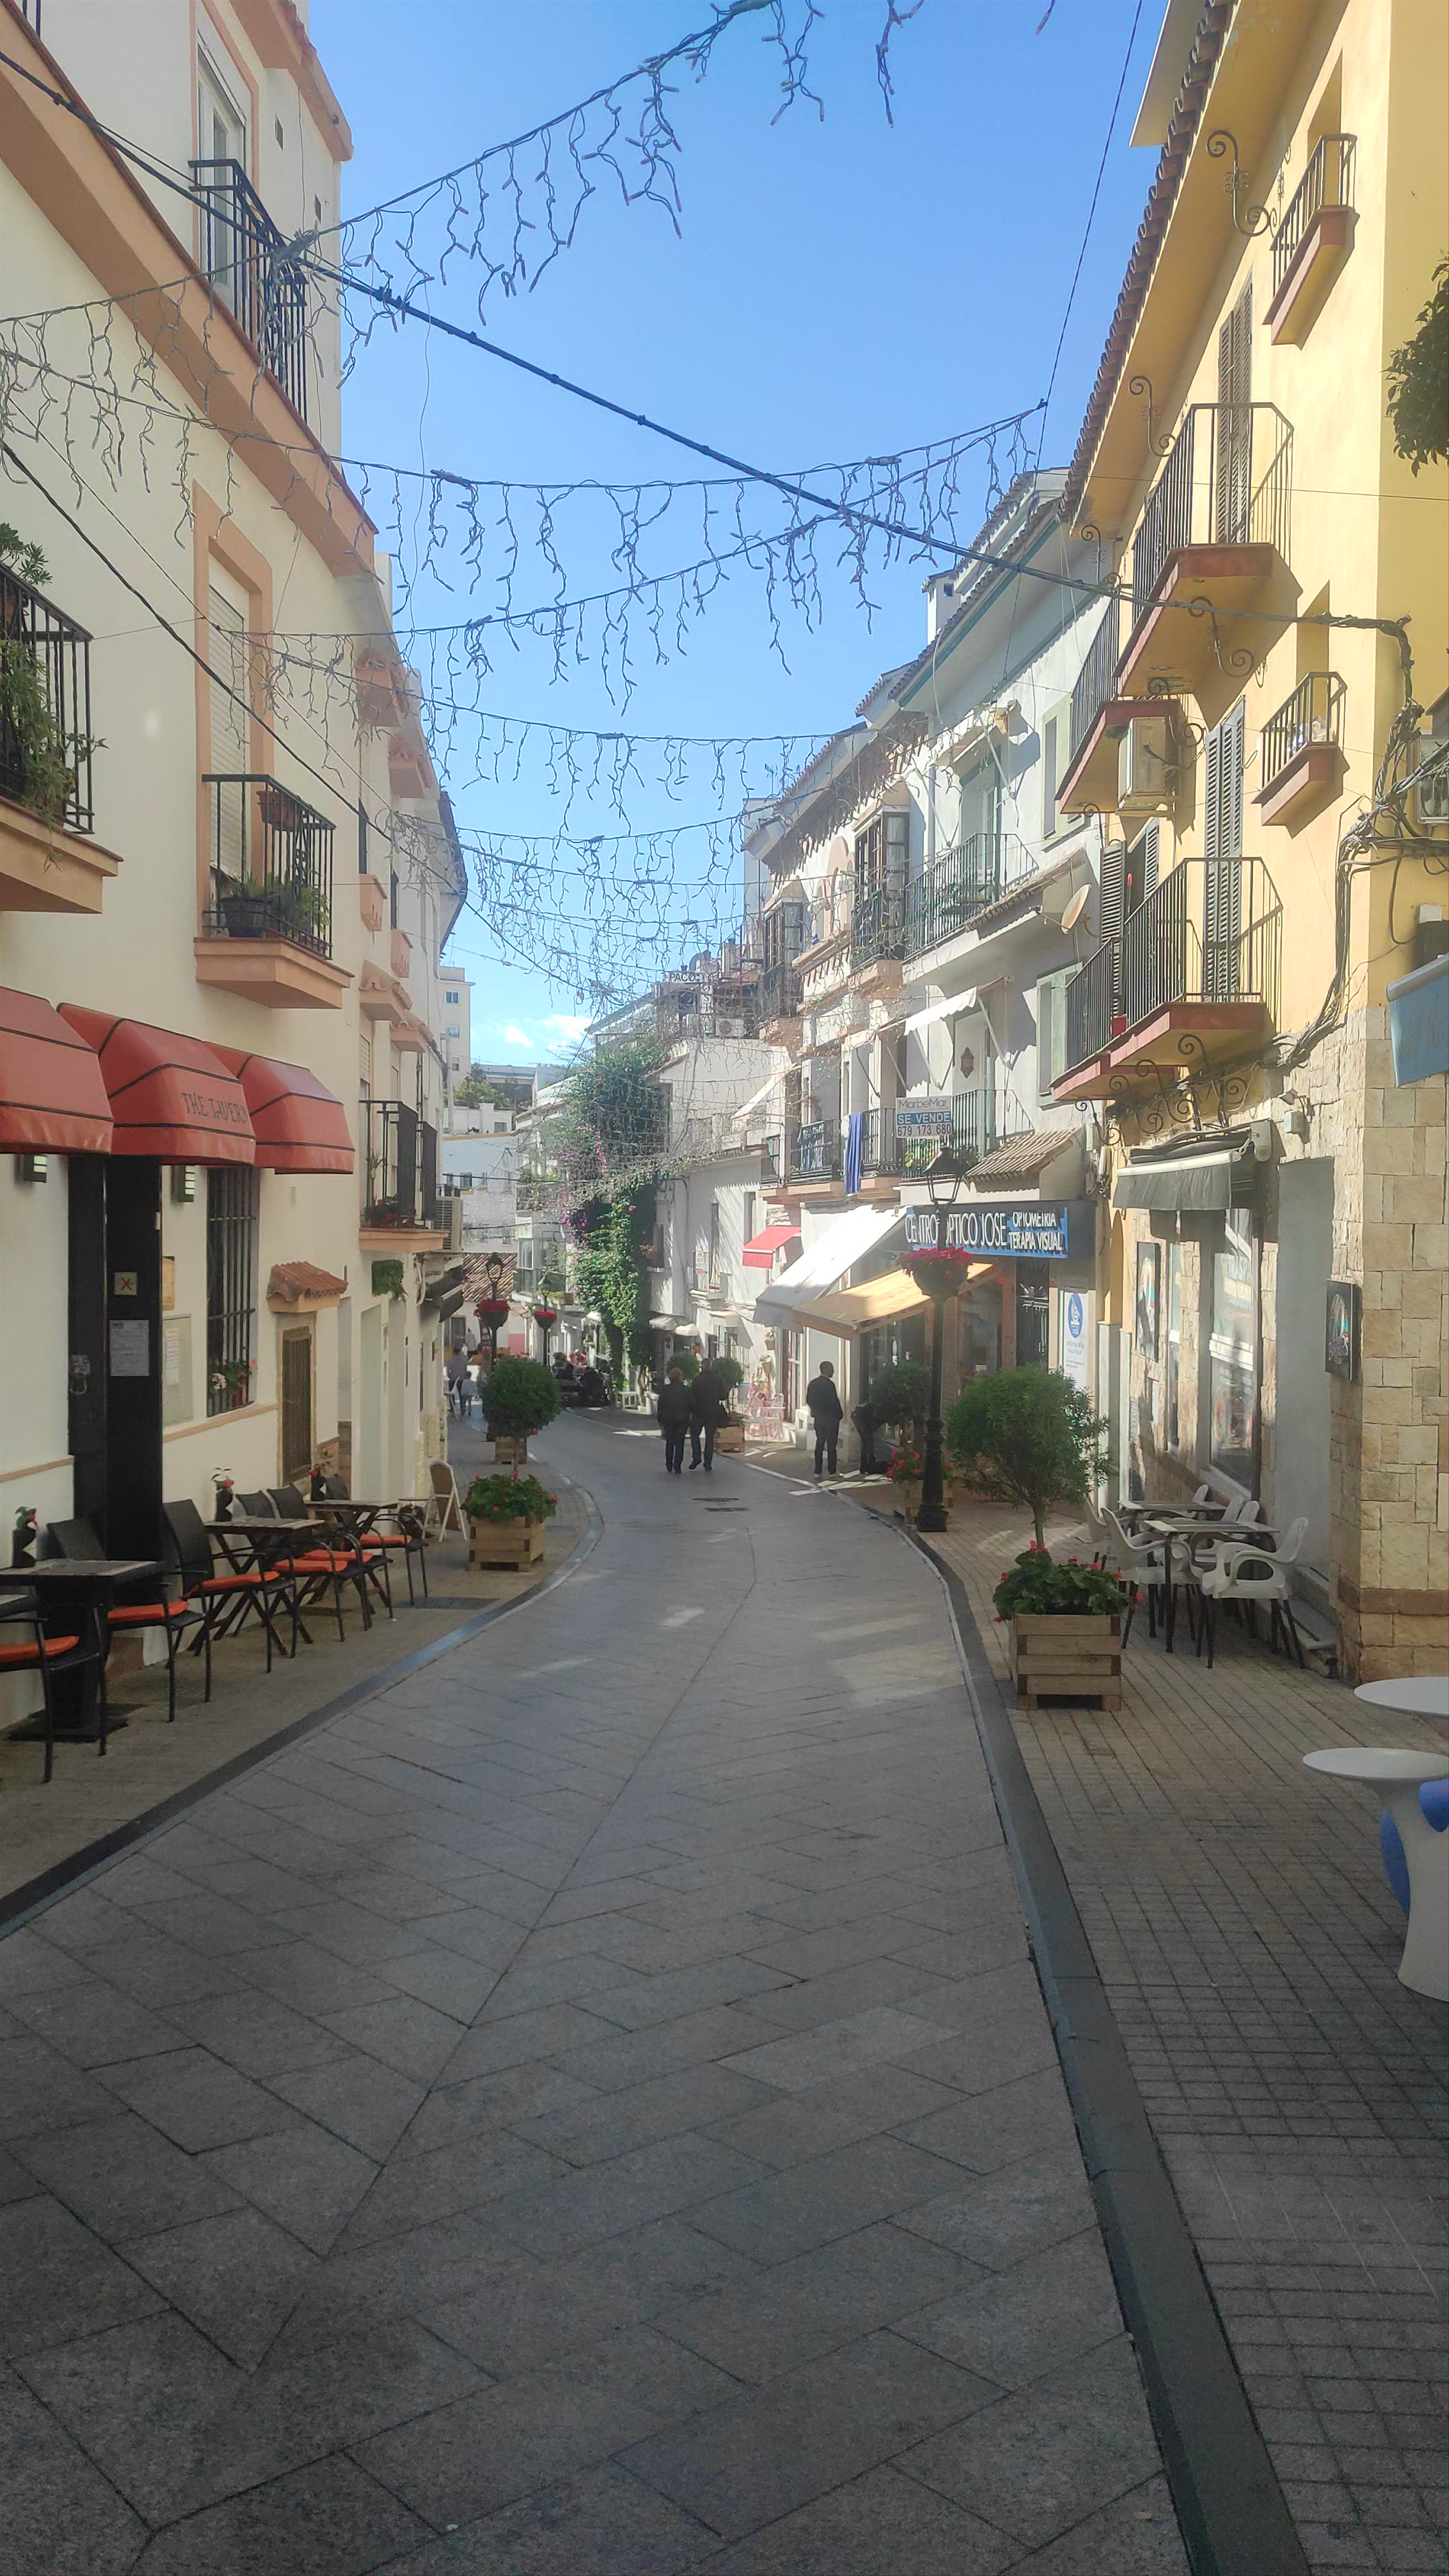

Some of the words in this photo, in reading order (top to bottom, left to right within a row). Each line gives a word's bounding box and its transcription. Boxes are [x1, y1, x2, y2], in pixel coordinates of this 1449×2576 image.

[182, 1093, 208, 1116] THE
[899, 1098, 948, 1109] MarbeMar
[898, 1115, 911, 1124] SE
[915, 1112, 950, 1123] VENDE
[897, 1126, 912, 1136] 679
[917, 1124, 932, 1135] 173
[936, 1123, 951, 1134] 680
[945, 1213, 978, 1245] PTICO
[1009, 1232, 1036, 1250] TERAPIA
[1037, 1232, 1063, 1250] VISUAL
